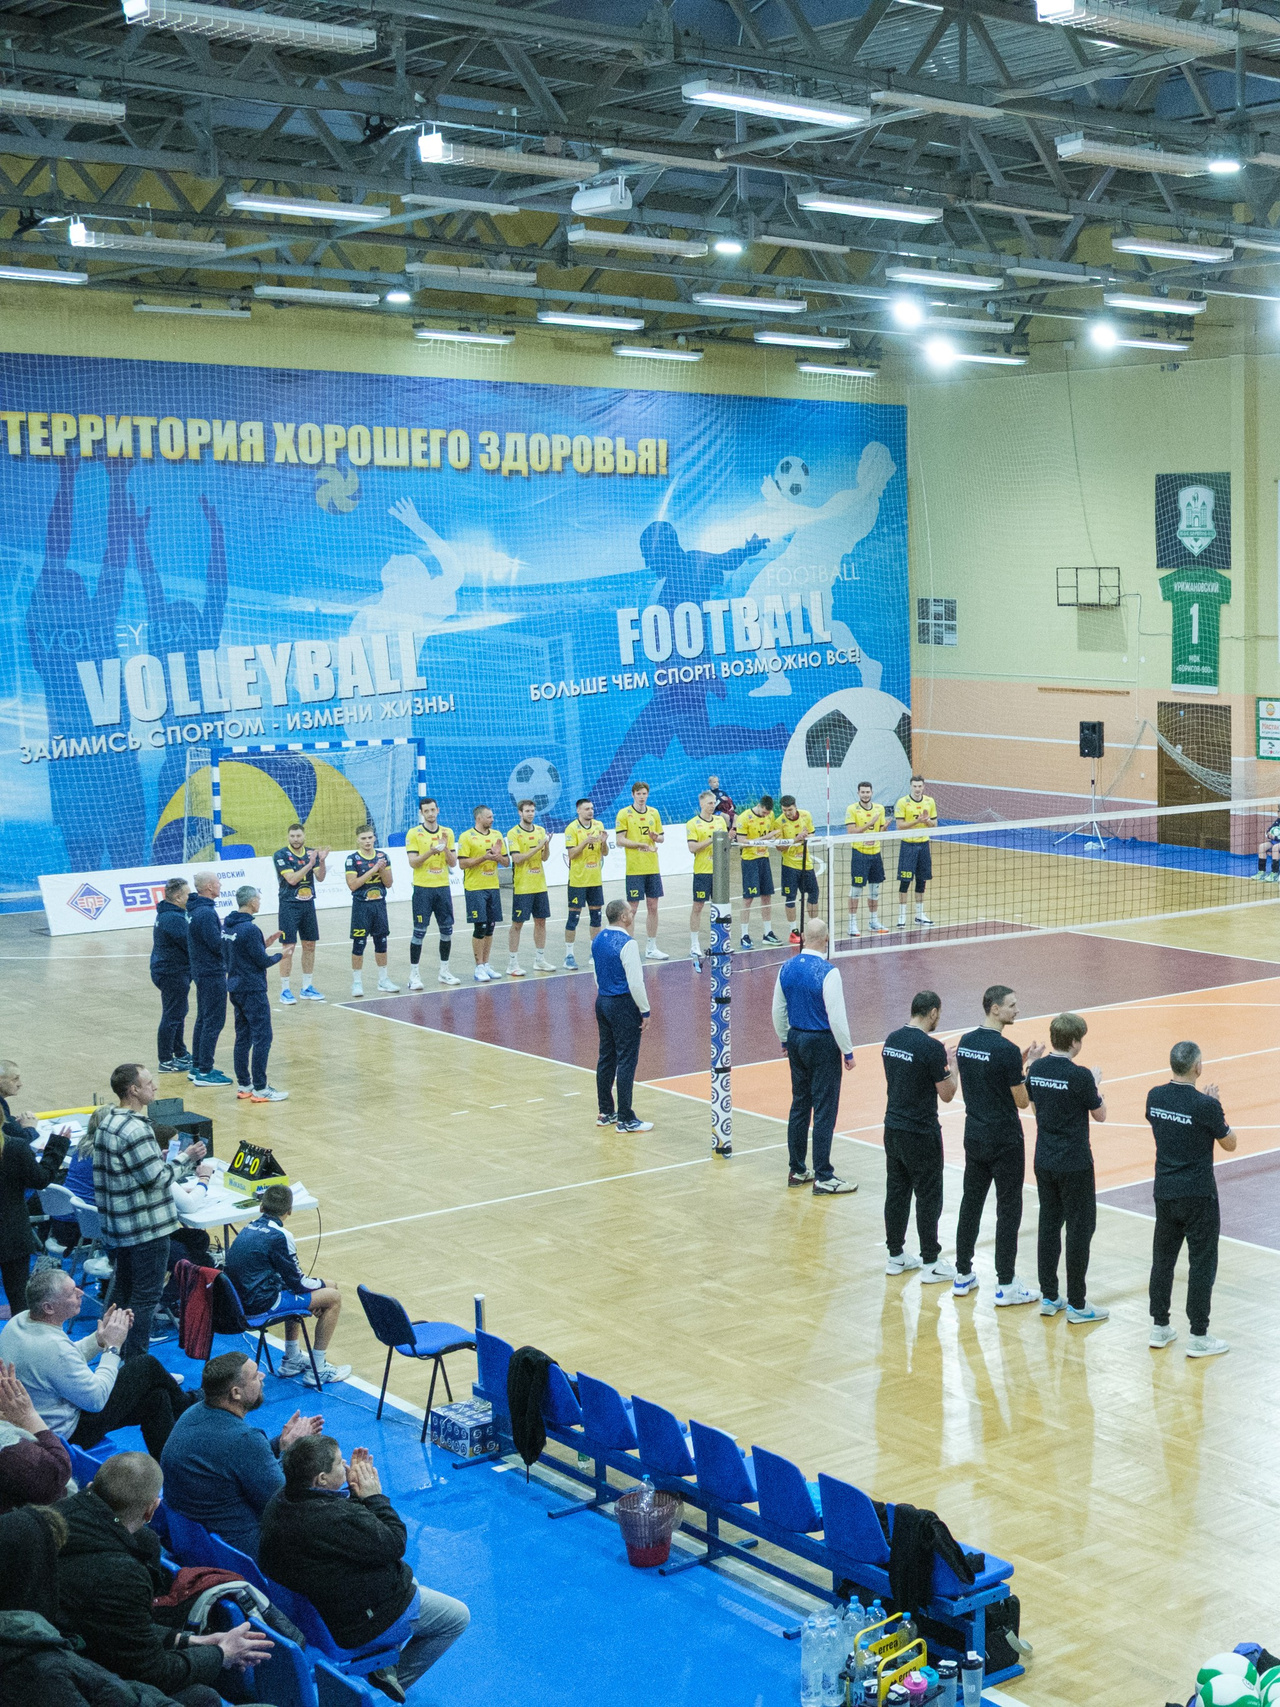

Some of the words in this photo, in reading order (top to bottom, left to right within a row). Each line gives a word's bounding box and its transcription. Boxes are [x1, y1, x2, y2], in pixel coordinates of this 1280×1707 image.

[1, 411, 264, 464] ТЕРРИТОРИЯ
[275, 421, 471, 470] ХОРОШЕГО
[479, 429, 669, 477] ЗДОРОВЬЯ!
[617, 591, 833, 665] FOOTBALL
[1190, 603, 1199, 645] 1
[77, 632, 427, 727] VOLLEYBALL
[530, 672, 608, 702] БОЛЬШЕ
[612, 669, 650, 691] ЧЕМ
[654, 662, 717, 687] СПОРТ!
[720, 650, 822, 679] ВОЗМОЖНО
[826, 647, 861, 666] ВСЕ!
[19, 731, 142, 764] ЗАЙМИСЬ
[149, 716, 265, 748] СПОРТОМ
[287, 704, 373, 731] ИЗМЕНИ
[380, 694, 457, 719] ЖИЗНЬ!
[216, 868, 245, 880] ОВСКИЙ
[630, 889, 639, 897] 12
[748, 887, 758, 895] 14
[472, 911, 478, 919] 3
[516, 910, 522, 918] 7
[353, 929, 366, 937] 22
[883, 1050, 913, 1062] СТОЛИЦА
[957, 1050, 990, 1062] СТОЛИЦА
[1030, 1081, 1069, 1090] СТОЛИЦА
[1150, 1110, 1193, 1125] СТОЛИЦА
[234, 1152, 245, 1168] 0
[249, 1158, 260, 1175] 0
[878, 1639, 899, 1656] errea
